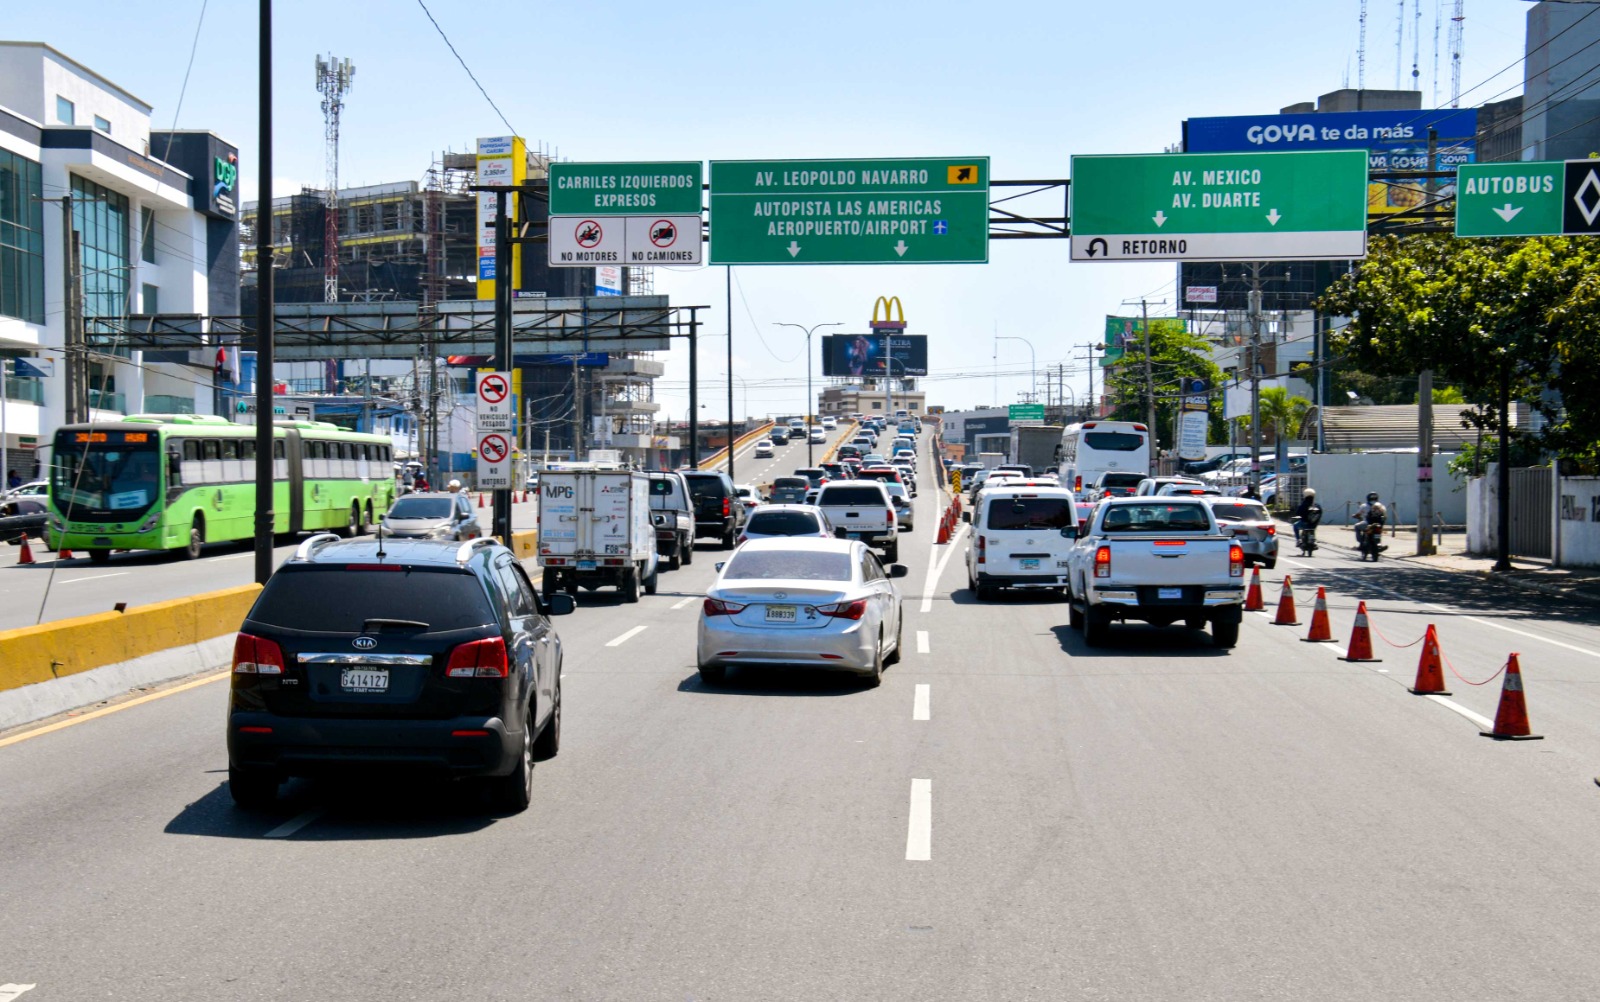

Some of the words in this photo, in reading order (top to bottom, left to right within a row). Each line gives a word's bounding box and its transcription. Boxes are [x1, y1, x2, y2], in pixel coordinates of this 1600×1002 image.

[1247, 124, 1315, 144] GOYA
[1321, 127, 1341, 140] te
[1344, 125, 1368, 139] da
[1373, 123, 1414, 138] más
[1369, 156, 1387, 167] YA
[1391, 156, 1428, 168] GOYA
[1441, 155, 1468, 164] GOYA
[558, 176, 616, 189] CARRILES
[621, 175, 693, 189] IZQUIERDOS
[755, 171, 778, 186] AV.
[784, 170, 856, 186] LEOPOLDO
[862, 169, 928, 185] NAVARRO
[1172, 171, 1197, 186] AV.
[1202, 169, 1262, 185] MEXICO
[1465, 175, 1554, 195] AUTOBUS
[595, 194, 656, 207] EXPRESOS
[1172, 193, 1196, 208] AV.
[1202, 192, 1261, 208] DUARTE
[754, 201, 832, 216] AUTOPISTA
[837, 201, 862, 216] LAS
[867, 200, 942, 215] AMERICAS
[768, 220, 927, 236] AEROPUERTO/AIRPORT
[1122, 239, 1187, 254] RETORNO
[561, 252, 573, 261] NO
[576, 252, 618, 261] MOTORES
[632, 252, 643, 260] NO
[647, 251, 693, 260] CAMIONES
[482, 420, 506, 428] PESADOS
[489, 467, 498, 475] NO
[546, 486, 573, 499] MPG
[342, 674, 388, 687] G414127
